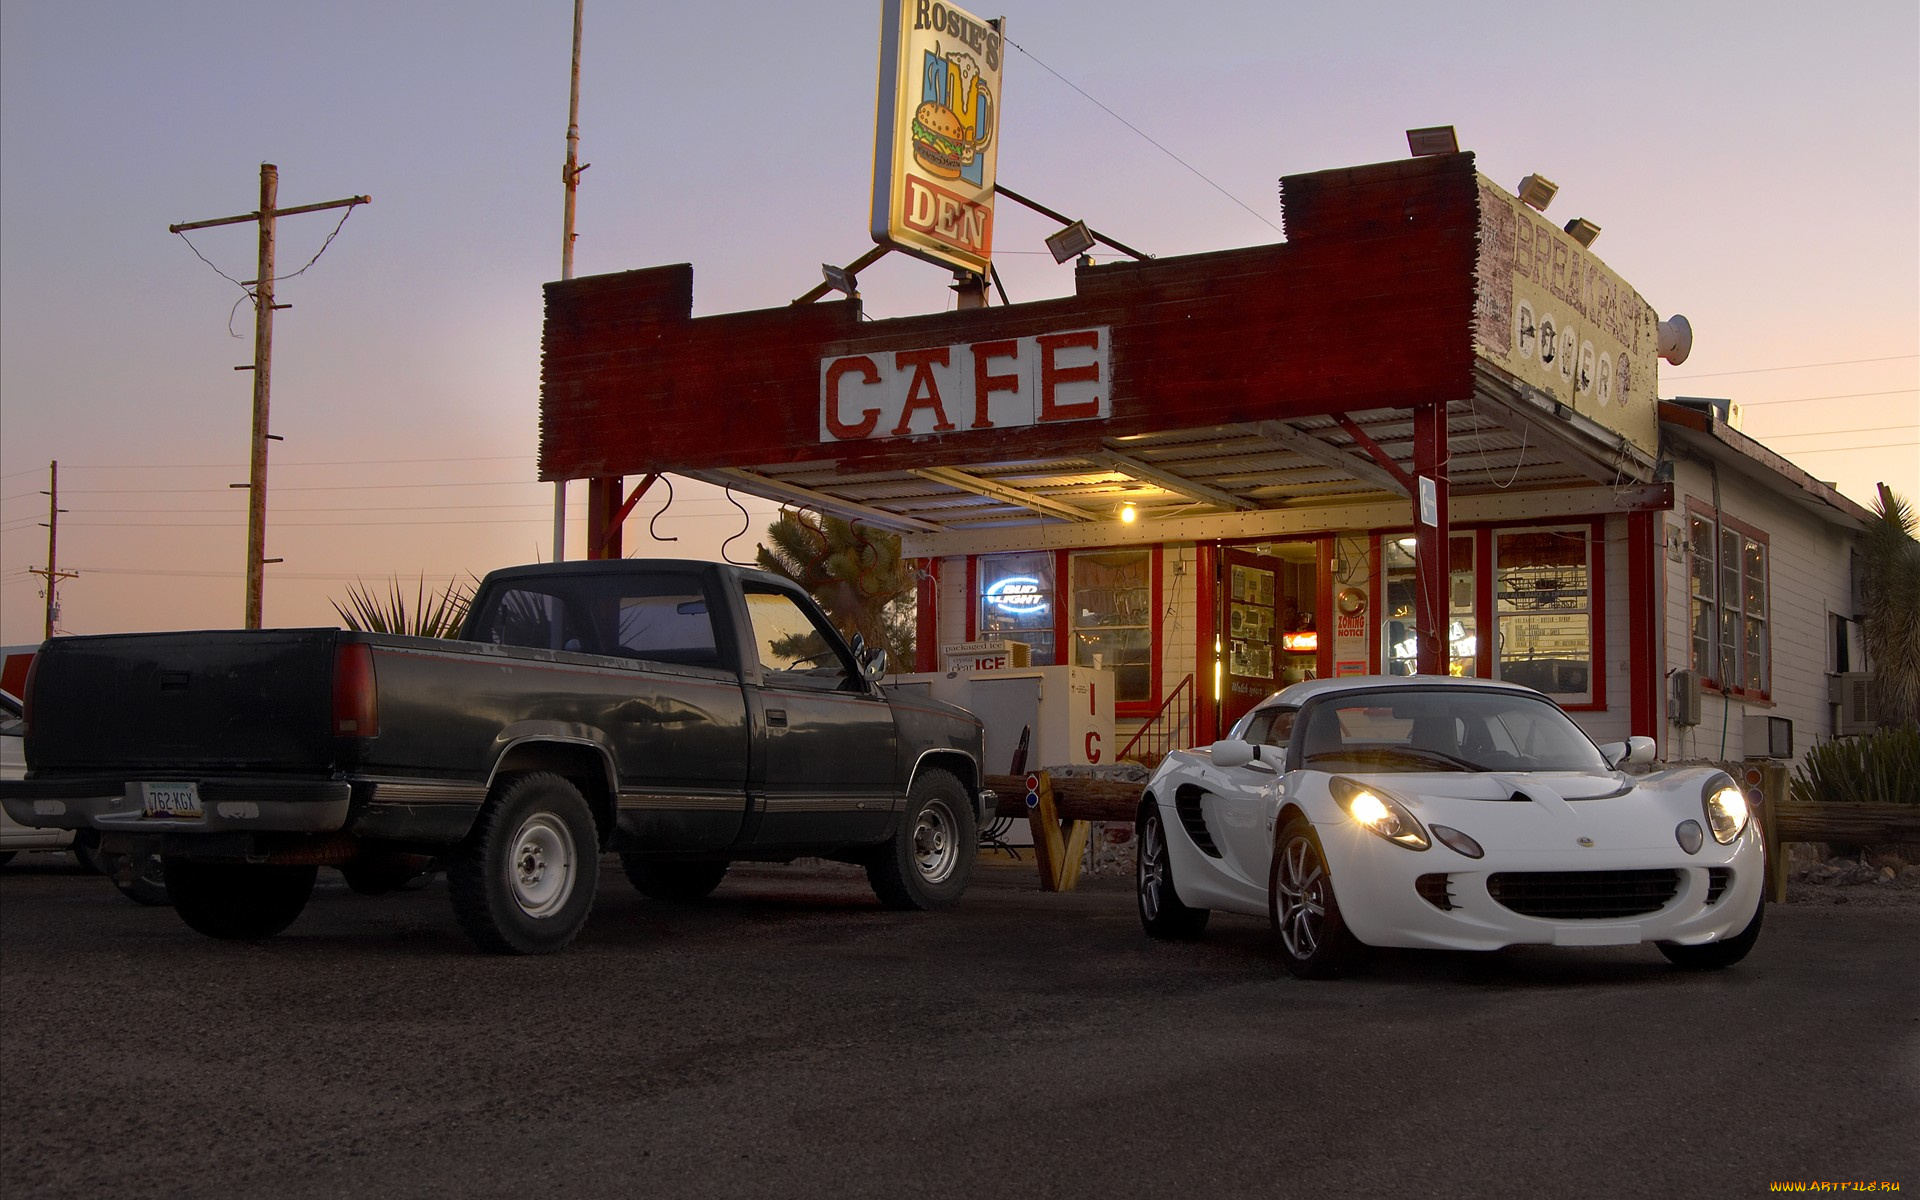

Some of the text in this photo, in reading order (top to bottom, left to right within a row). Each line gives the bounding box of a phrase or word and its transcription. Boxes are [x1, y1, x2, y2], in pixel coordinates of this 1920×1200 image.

[914, 0, 999, 71] ROSIE'S
[909, 181, 986, 250] DEN
[1514, 212, 1642, 355] BREAKFAST
[825, 330, 1100, 440] CAFE
[1002, 585, 1038, 594] BUD
[994, 595, 1043, 604] LIGHT
[1337, 616, 1365, 629] ZONING
[1337, 629, 1364, 637] NOTICE
[945, 643, 987, 653] packaged
[951, 663, 974, 672] clear
[975, 656, 1006, 671] ICE
